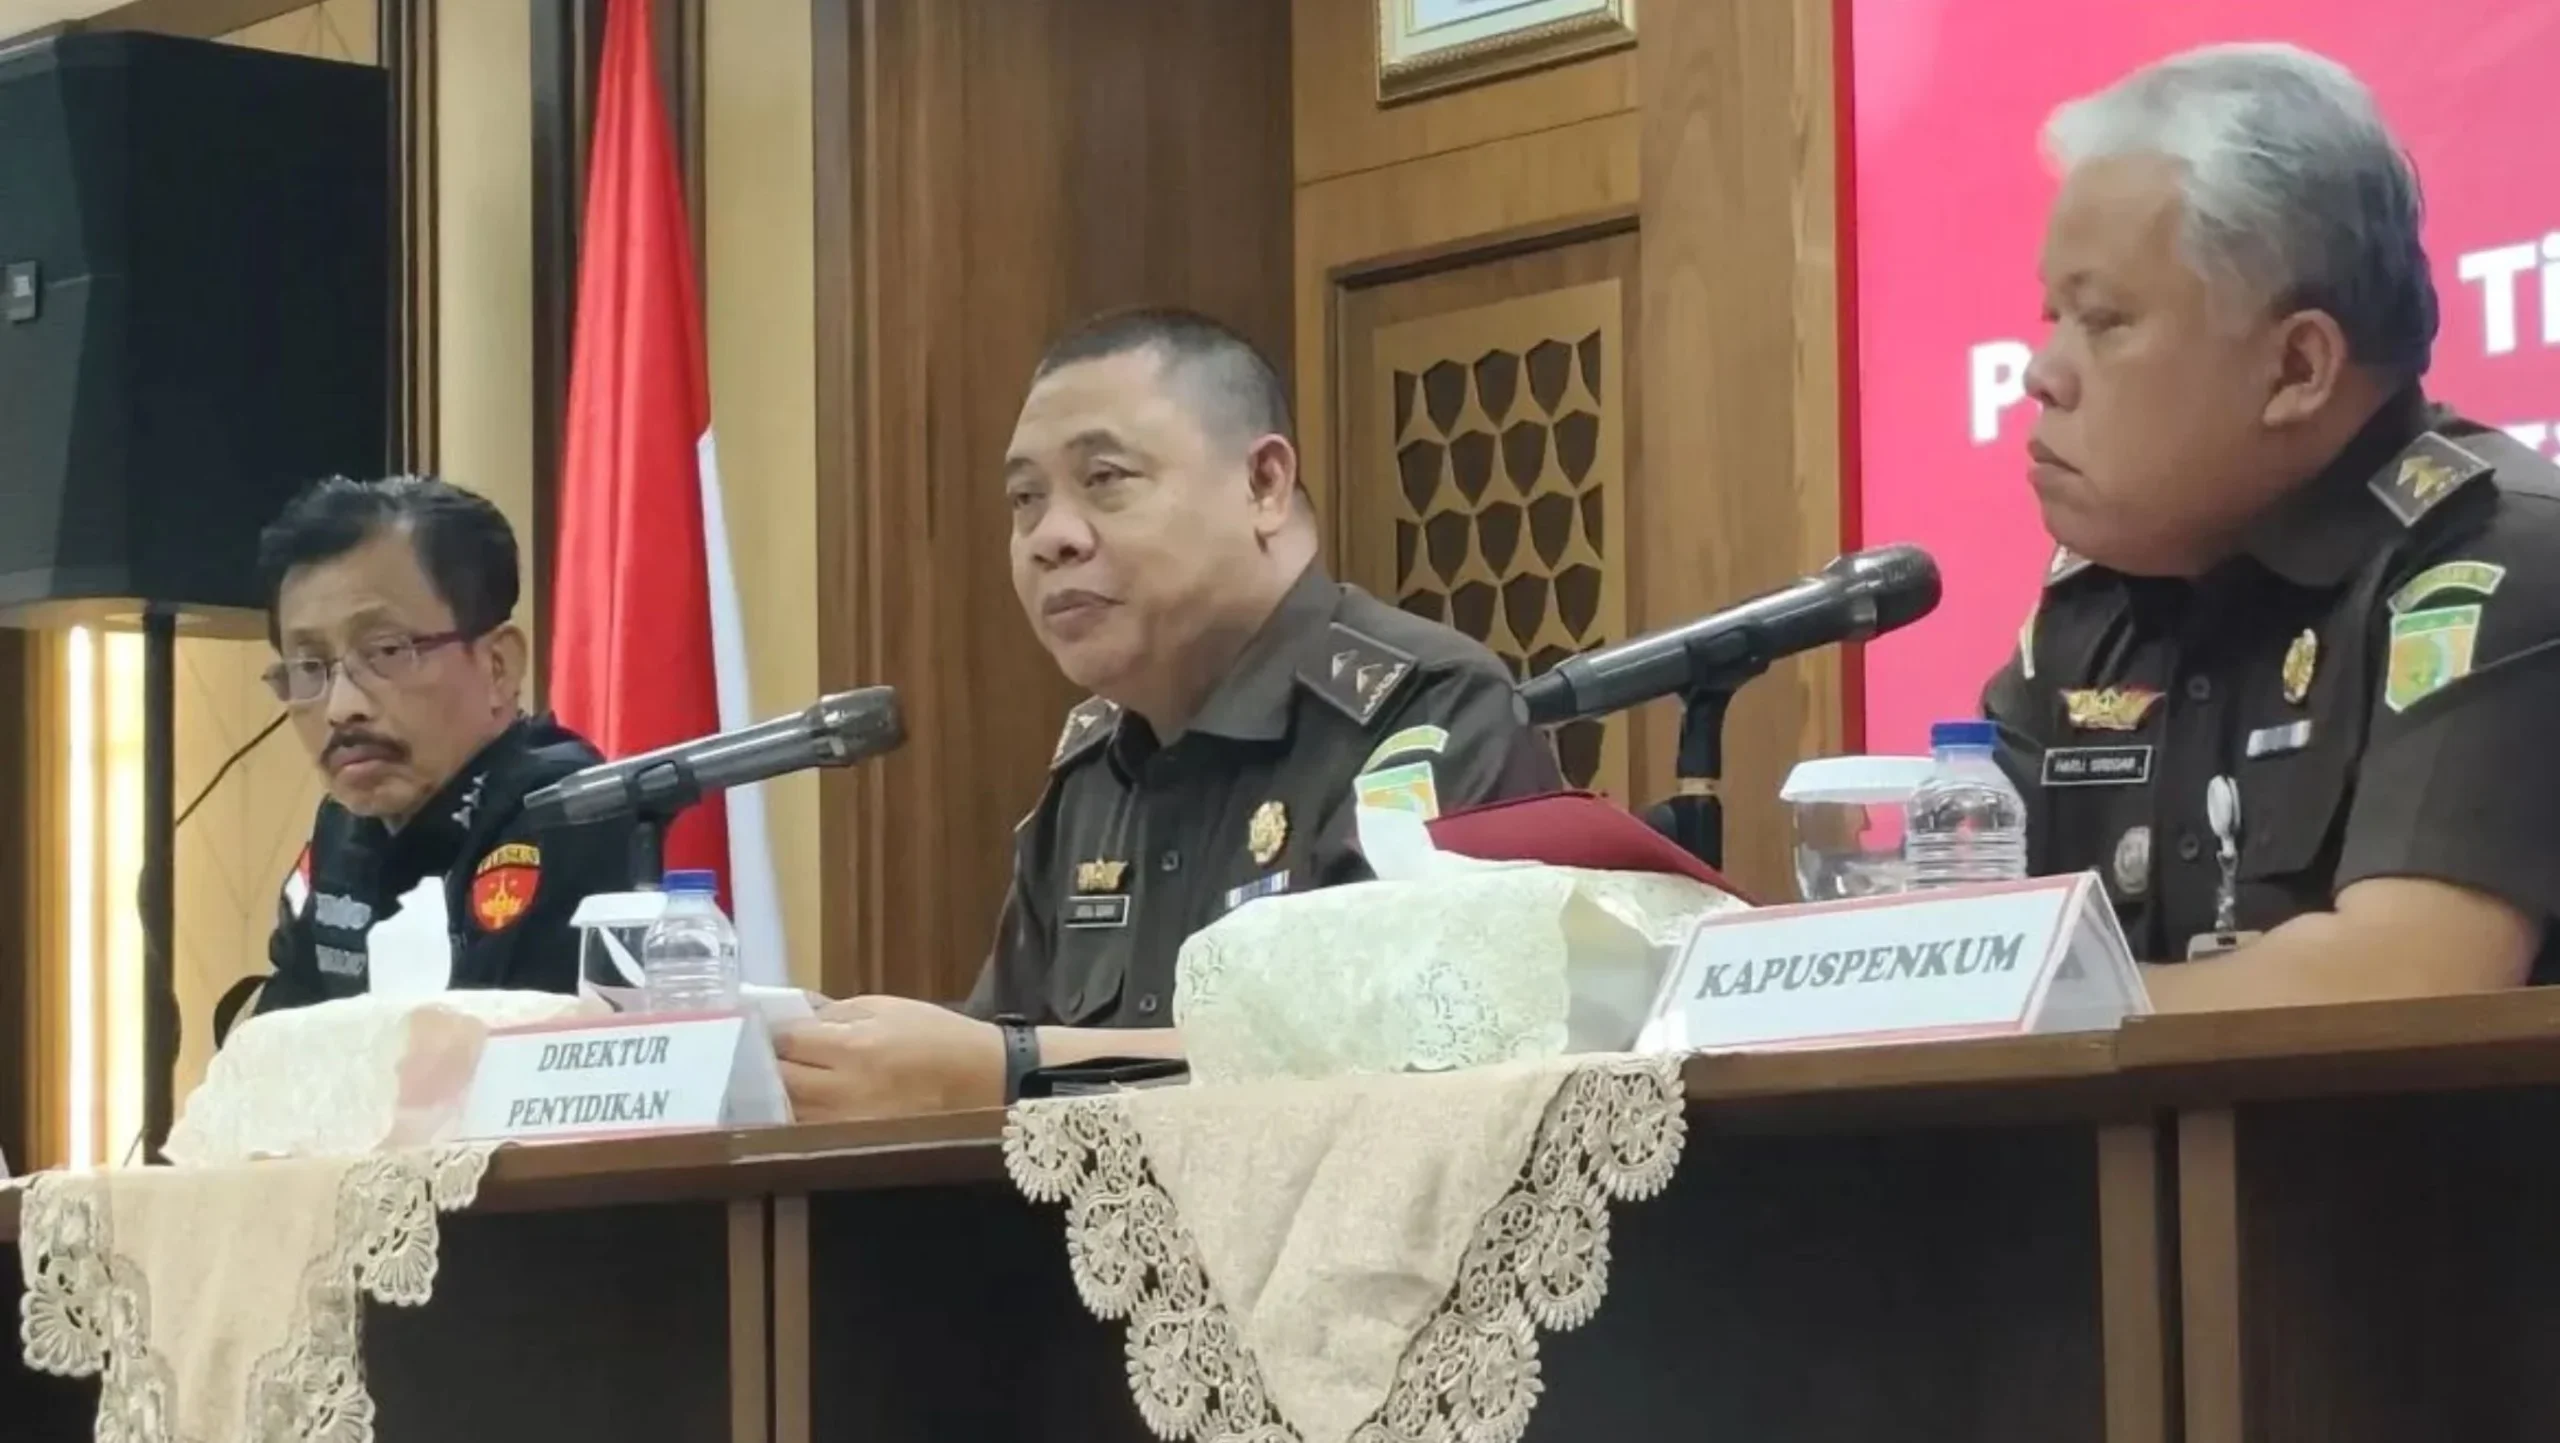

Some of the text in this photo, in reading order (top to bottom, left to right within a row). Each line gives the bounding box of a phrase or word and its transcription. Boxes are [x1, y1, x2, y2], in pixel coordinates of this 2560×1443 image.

[1695, 933, 2025, 1000] KAPUSPENKUM
[538, 1036, 670, 1072] DIREKTUR
[506, 1090, 670, 1128] PENYIDIKAN
